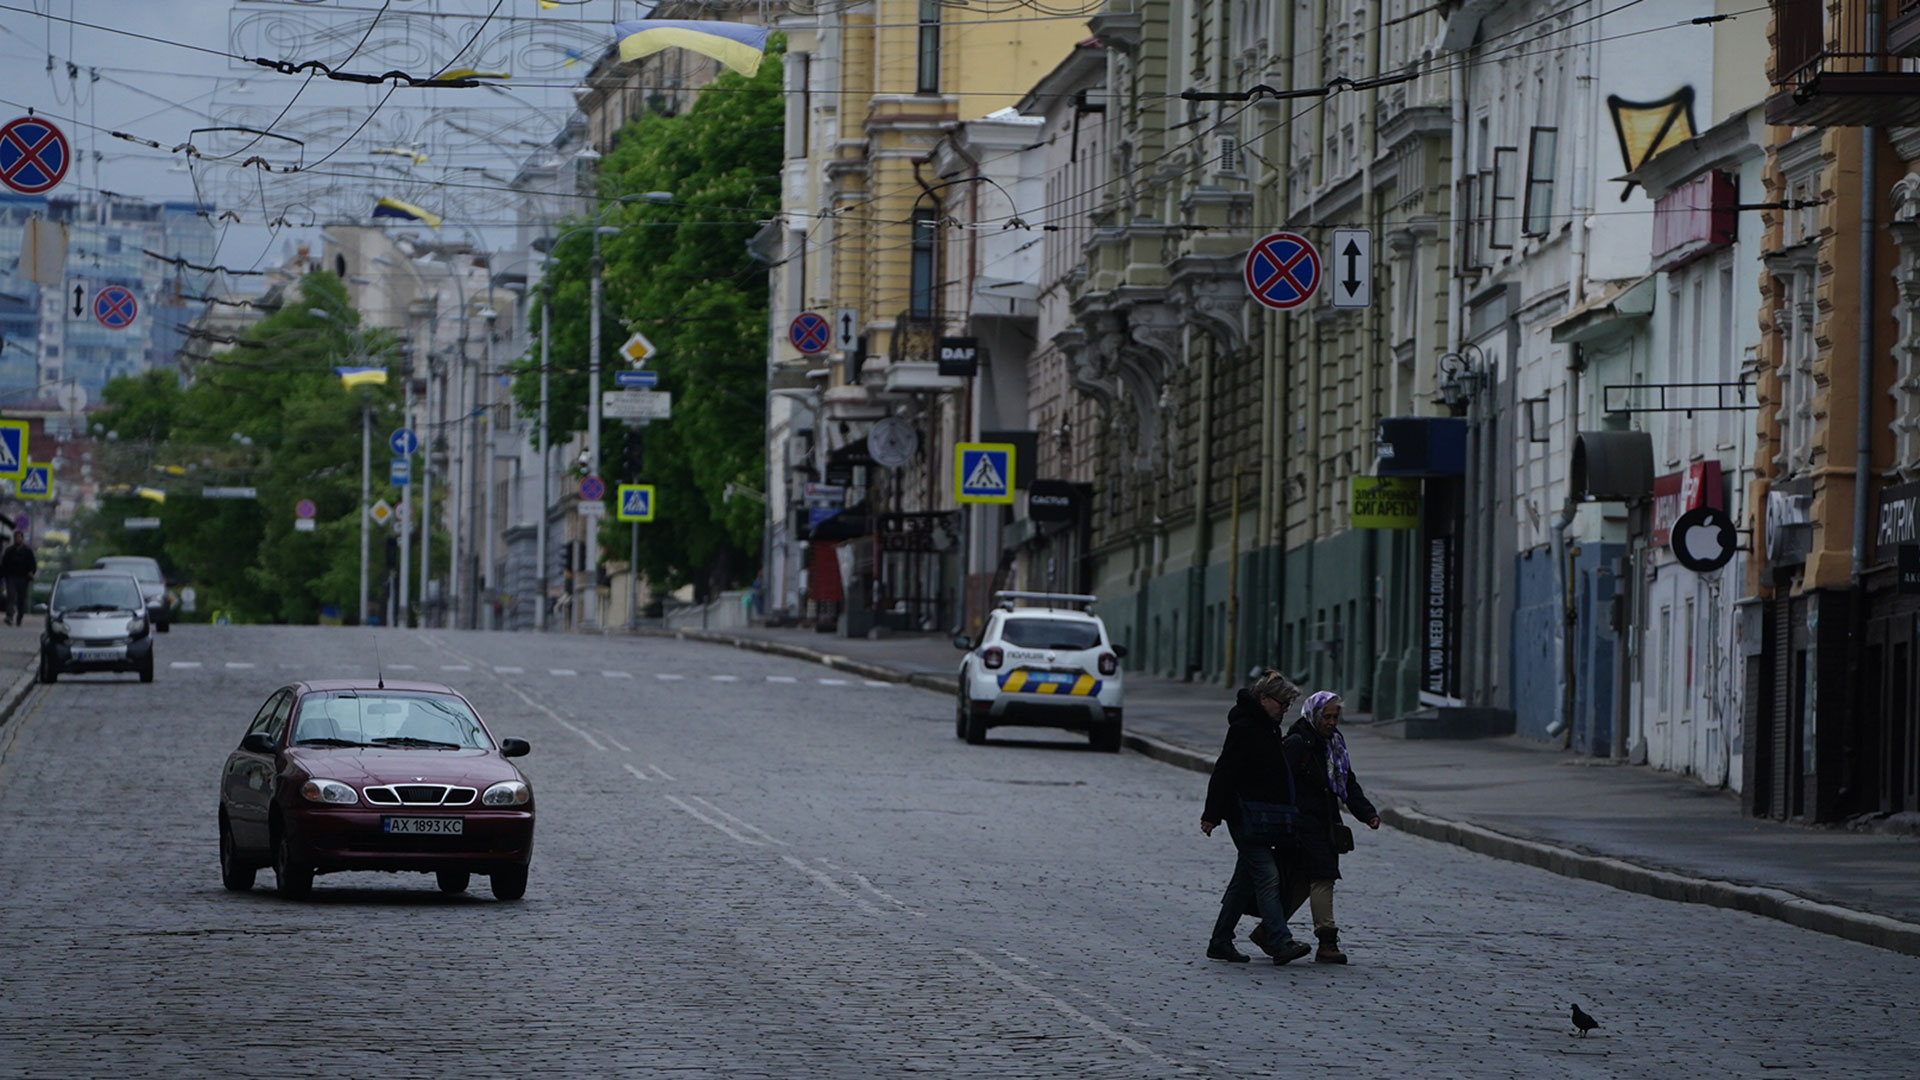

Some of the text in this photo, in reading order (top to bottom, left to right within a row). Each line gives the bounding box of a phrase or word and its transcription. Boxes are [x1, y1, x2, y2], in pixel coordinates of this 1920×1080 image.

[1354, 501, 1418, 517] СИГАРЕТЫ
[1877, 496, 1917, 546] PATRIK
[1429, 538, 1446, 693] ALL YOU NEED IS CLOUDMANIA
[391, 819, 462, 833] AX 1893 KC
